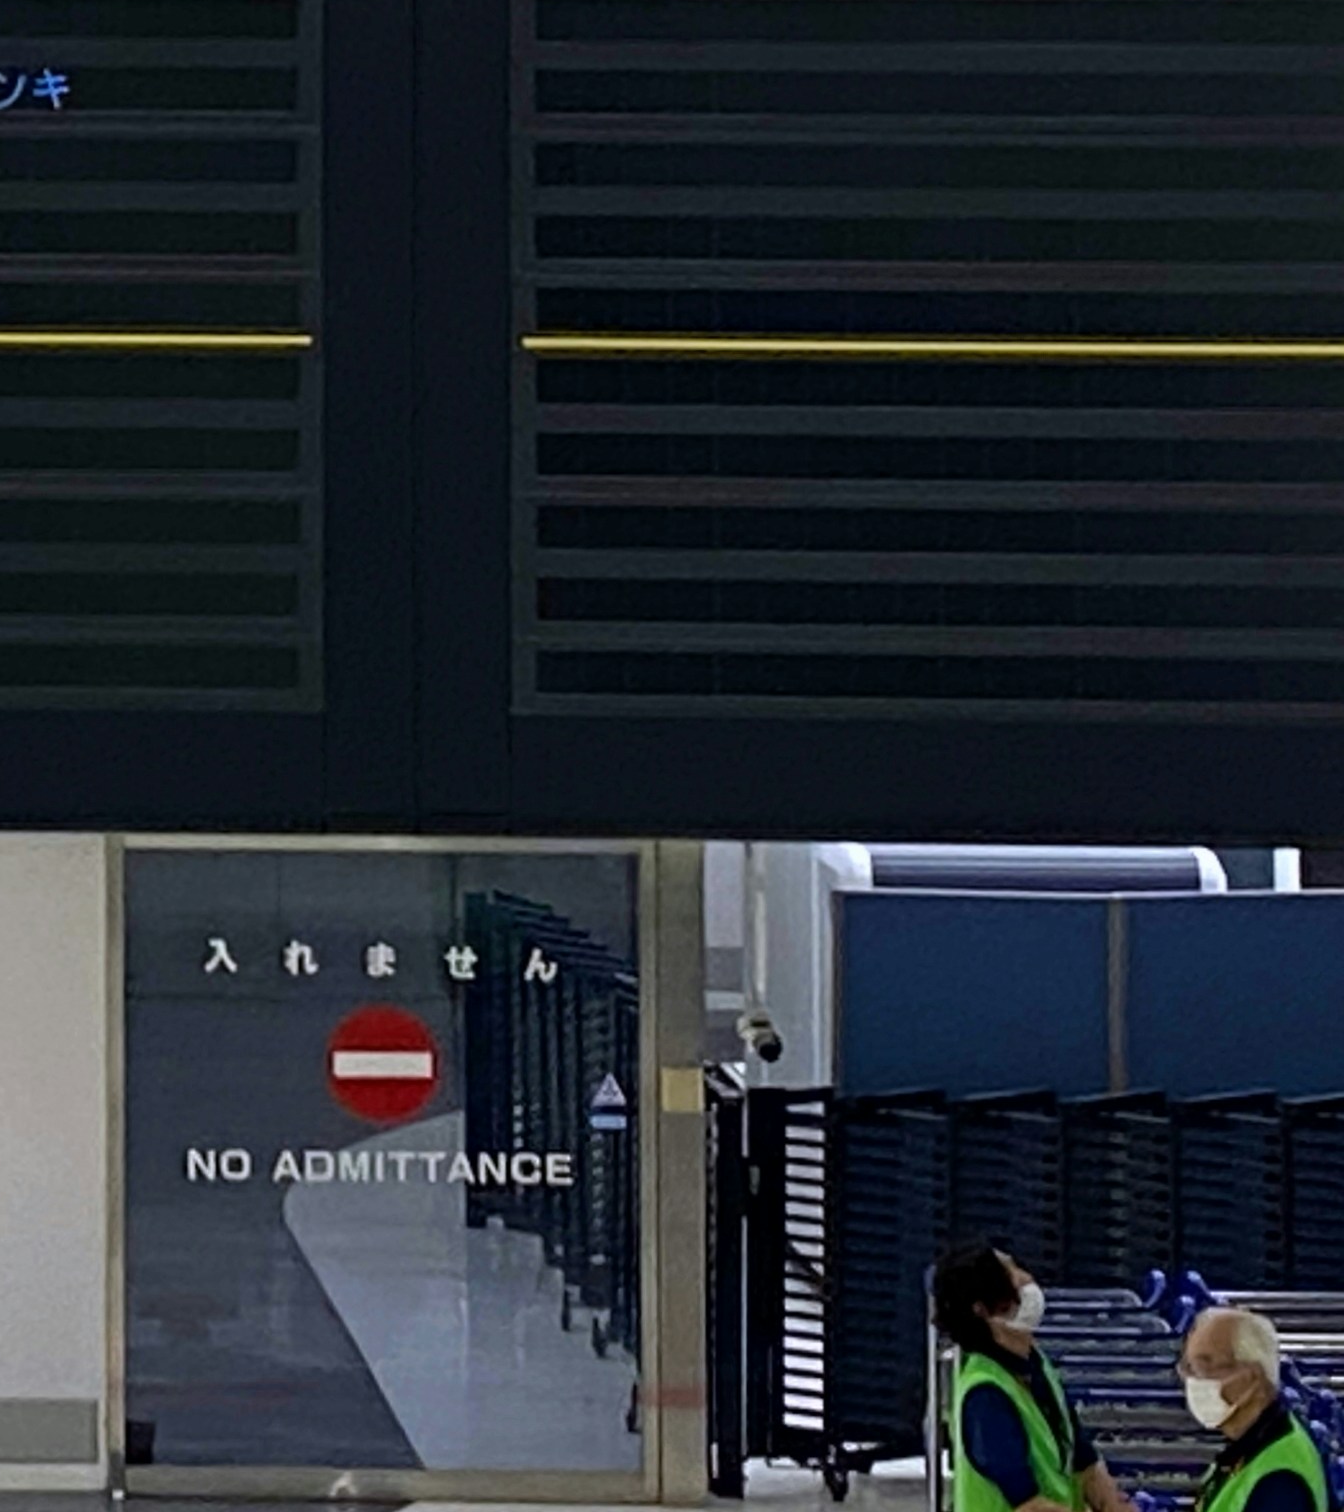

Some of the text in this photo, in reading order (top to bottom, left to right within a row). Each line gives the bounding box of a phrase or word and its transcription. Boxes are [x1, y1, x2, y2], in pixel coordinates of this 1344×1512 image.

[204, 937, 558, 983] 入れません
[186, 1147, 574, 1186] NO ADMITTANCE
